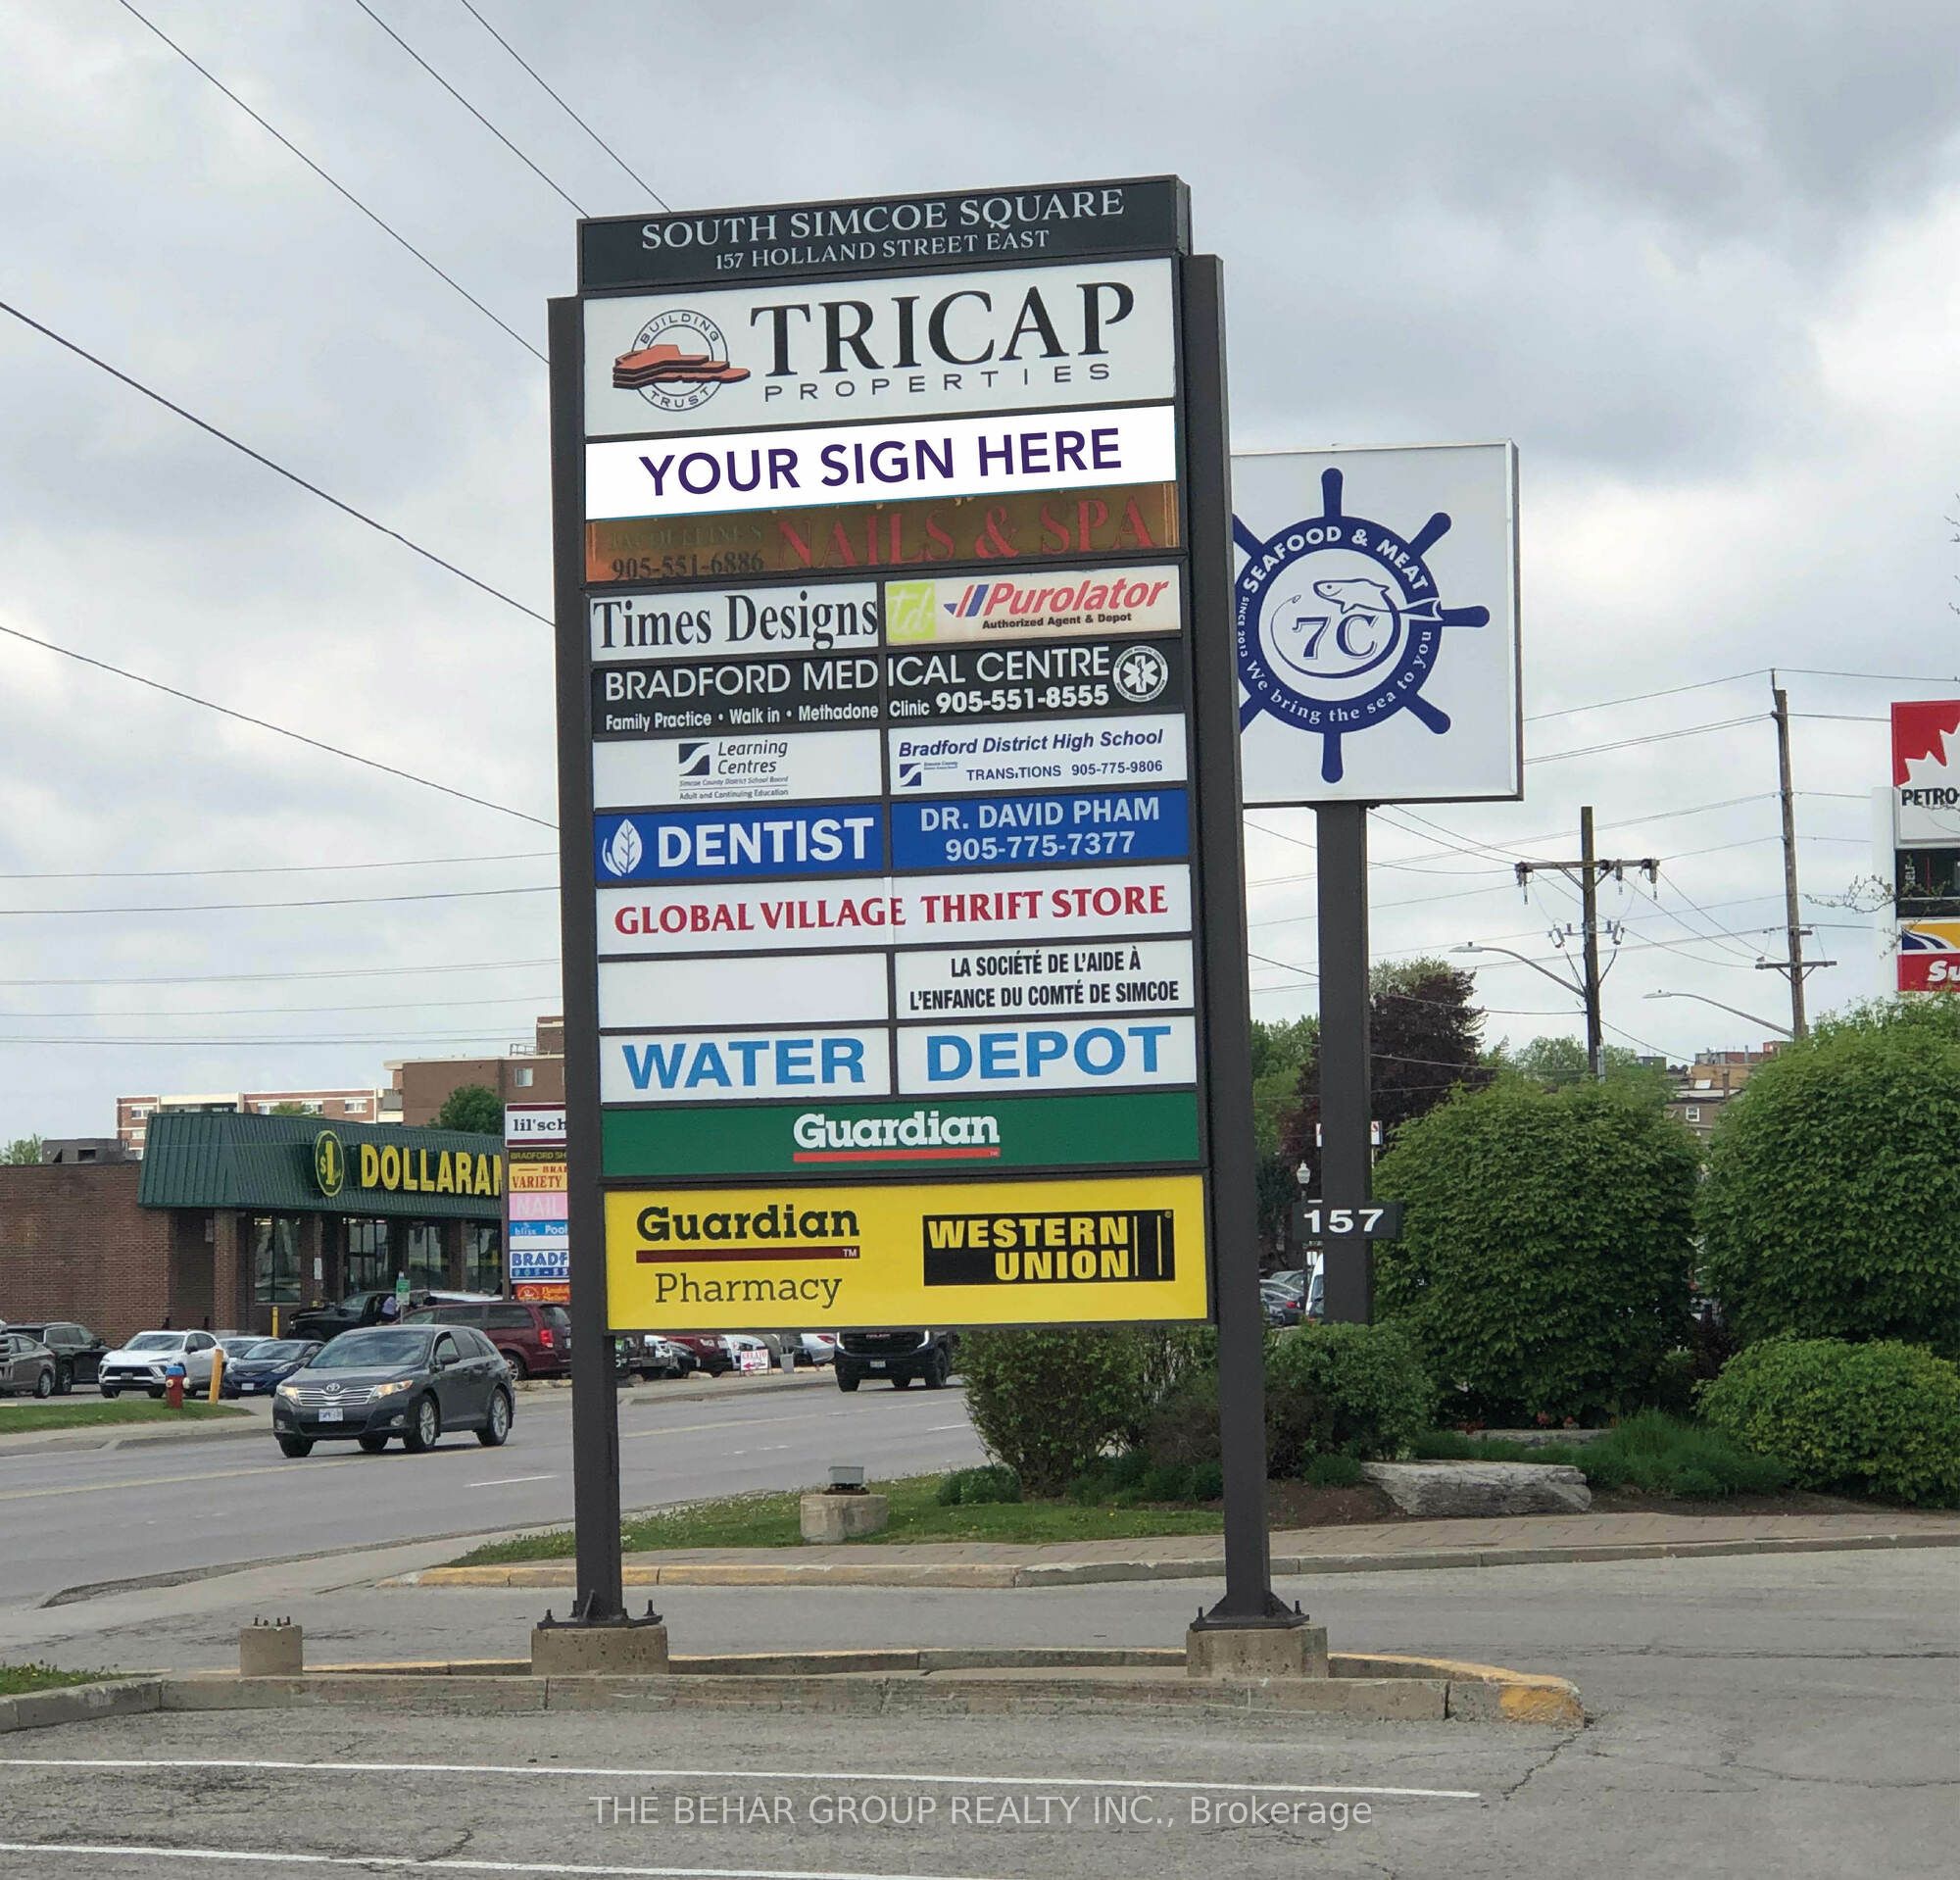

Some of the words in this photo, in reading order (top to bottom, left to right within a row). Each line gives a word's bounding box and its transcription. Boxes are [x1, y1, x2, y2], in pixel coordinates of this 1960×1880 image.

[641, 214, 777, 250] SOUTH
[790, 202, 948, 239] SIMCOE
[959, 188, 1125, 230] SQUARE
[715, 252, 745, 270] 157
[752, 241, 875, 268] HOLLAND
[882, 234, 979, 259] STREET
[987, 229, 1050, 251] EAST
[640, 313, 720, 345] BUILDING
[750, 281, 1135, 377] TRICAP
[650, 385, 710, 409] TRUST
[764, 363, 1110, 403] PROPERTIES
[638, 447, 802, 497] YOUR
[820, 437, 956, 487] SIGN
[977, 427, 1123, 477] HERE
[778, 508, 956, 569] NAILS
[973, 505, 1021, 560] &
[1039, 493, 1160, 555] SPA
[1243, 525, 1343, 594] SEAFOOD
[1350, 528, 1368, 548] &
[1376, 538, 1430, 591] MEAT
[983, 577, 1170, 617] Purolator
[1237, 595, 1250, 627] SINCE
[593, 599, 712, 649] Times
[725, 590, 879, 650] Designs
[982, 614, 1044, 630] Authorized
[1048, 615, 1081, 628] Agent
[1085, 614, 1094, 623] &
[1098, 612, 1132, 625] Depot
[1237, 630, 1249, 659] 2013
[605, 664, 791, 702] BRADFORD
[976, 646, 1110, 682] CENTRE
[1246, 660, 1269, 691] We
[1270, 688, 1323, 725] bring
[1328, 706, 1361, 723] the
[1366, 690, 1397, 715] sea
[1397, 672, 1415, 690] to
[1412, 630, 1433, 670] you
[889, 699, 930, 717] Clinic
[936, 684, 1109, 714] 905-551-8555
[606, 713, 650, 732] Family
[655, 711, 712, 729] Practice
[728, 708, 763, 725] Walk
[767, 708, 780, 723] in
[798, 703, 879, 722] Methadone
[717, 739, 788, 758] Learning
[899, 738, 978, 757] Bradford
[982, 735, 1049, 753] District
[1053, 731, 1094, 752] High
[1100, 728, 1163, 747] School
[717, 759, 777, 775] Centres
[1071, 760, 1163, 776] 905-775-9806
[714, 790, 753, 800] Continuing
[754, 788, 789, 797] Education
[920, 806, 969, 832] DR.
[979, 801, 1064, 829] DAVID
[1073, 797, 1160, 824] PHAM
[658, 816, 875, 868] DENTIST
[946, 830, 1136, 862] 905-775-7377
[614, 903, 755, 935] GLOBAL
[760, 897, 906, 931] VILLAGE
[921, 890, 1043, 924] THRIFT
[1052, 884, 1169, 918] STORE
[951, 957, 971, 978] LA
[975, 949, 1043, 977] SOCIÉTÉ
[1048, 953, 1069, 974] DE
[1074, 951, 1125, 972] L'AIDE
[1129, 945, 1141, 971] À
[909, 987, 996, 1011] L'ENFANCE
[1002, 986, 1022, 1008] DU
[1028, 979, 1084, 1006] COMTÉ
[1090, 982, 1111, 1004] DE
[1115, 980, 1180, 1003] SIMCOE
[621, 1037, 866, 1090] WATER
[926, 1025, 1172, 1082] DEPOT
[793, 1110, 1002, 1149] Guardian
[510, 1151, 554, 1161] BRADFORD
[512, 1175, 563, 1189] VARIETY
[636, 1204, 860, 1242] Guardian
[927, 1216, 1129, 1250] WESTERN
[1303, 1209, 1384, 1233] 157
[995, 1249, 1130, 1282] UNION
[655, 1272, 844, 1310] Pharmacy
